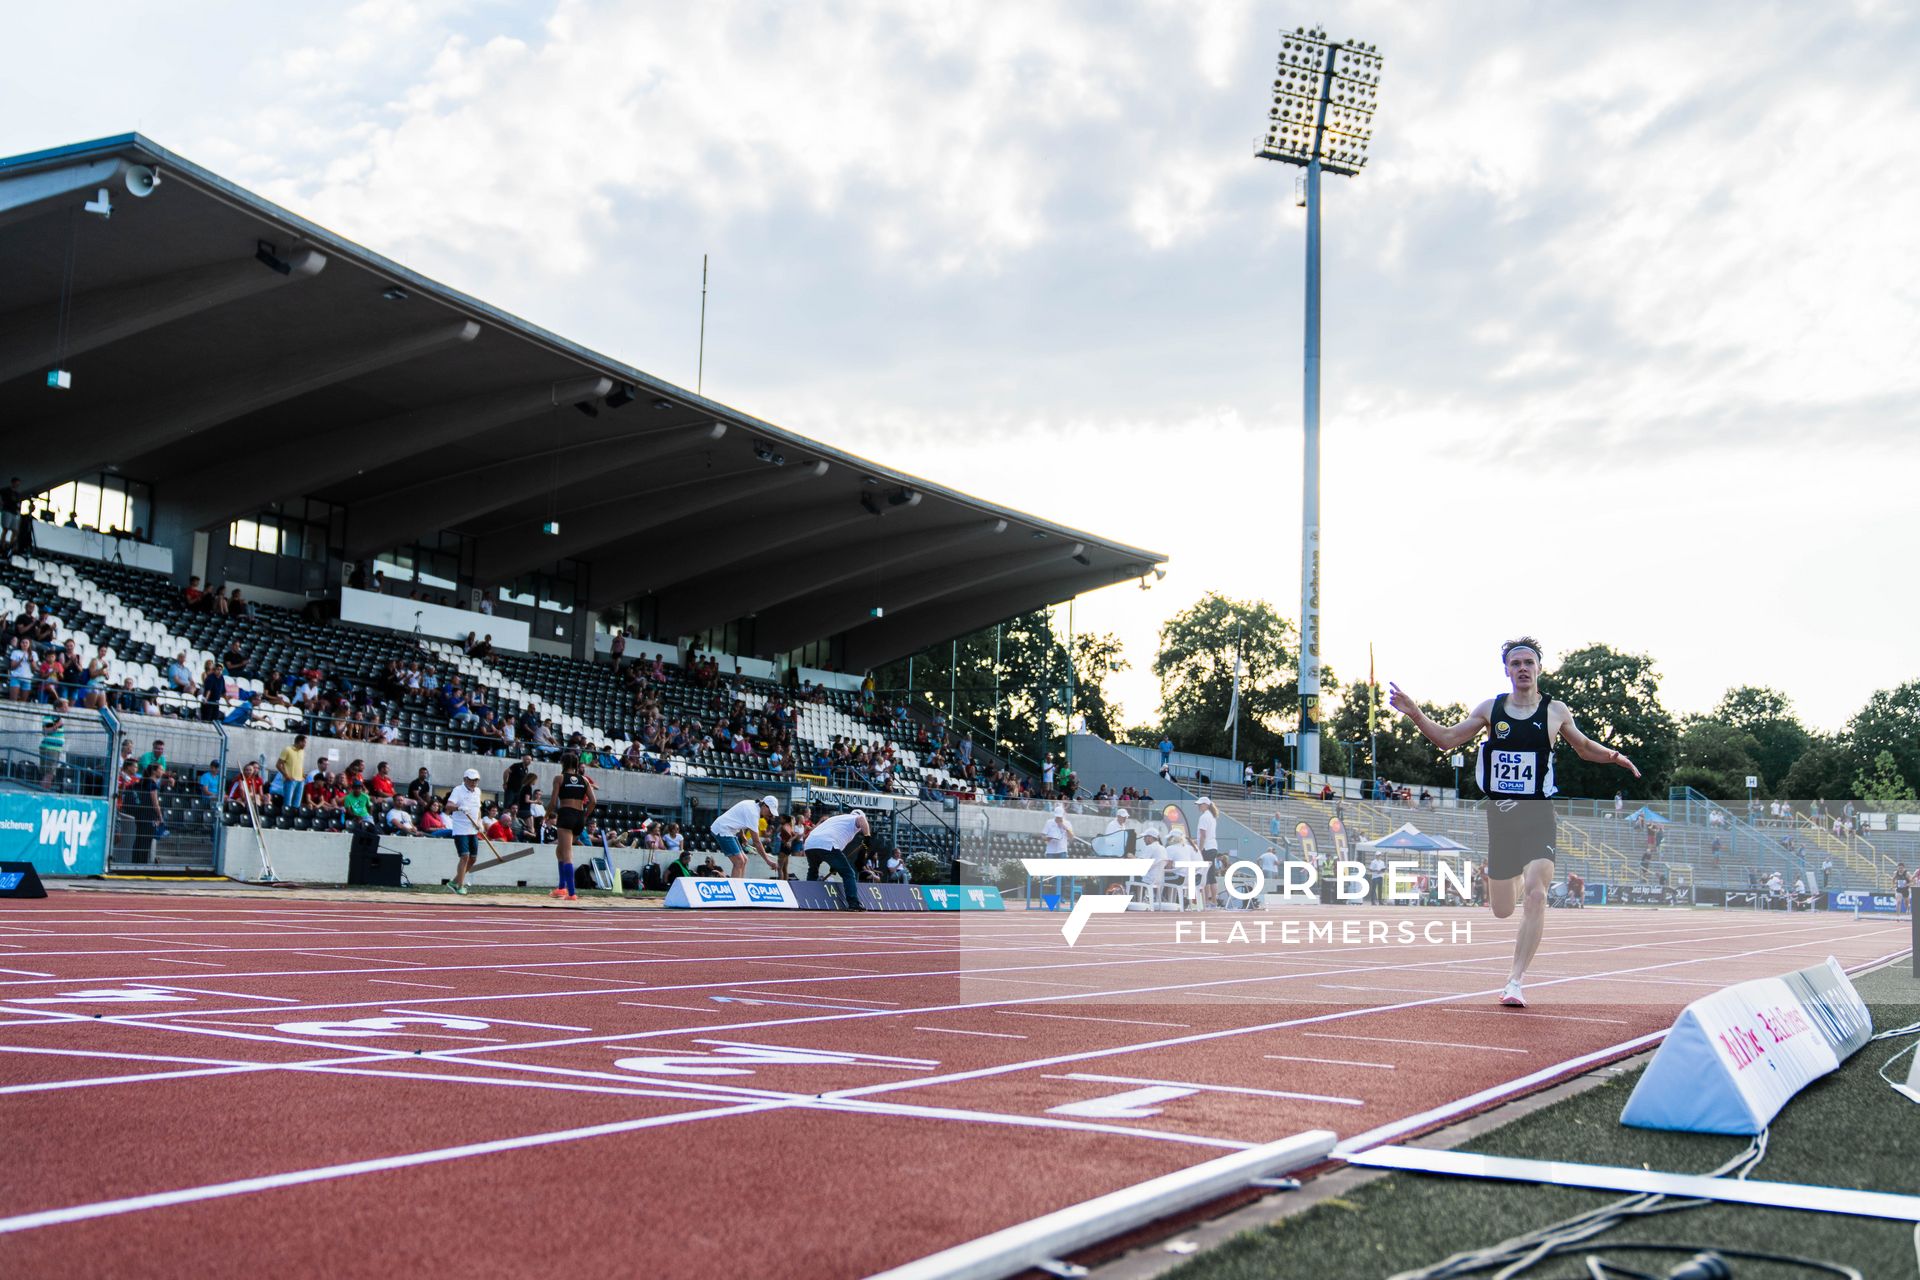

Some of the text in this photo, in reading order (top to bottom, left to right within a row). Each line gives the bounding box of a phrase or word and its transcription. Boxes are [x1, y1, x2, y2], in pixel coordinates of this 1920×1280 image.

[1499, 753, 1522, 764] GLS
[1494, 763, 1533, 780] 1214
[809, 790, 879, 807] DONAUSTADION ULM
[711, 885, 732, 895] PLAN
[759, 886, 780, 896] PLAN
[824, 884, 838, 898] 14
[869, 887, 883, 900] 13
[910, 887, 923, 900] 12
[273, 1017, 490, 1037] 3
[614, 1046, 855, 1075] 2
[1044, 1086, 1200, 1118] 1
